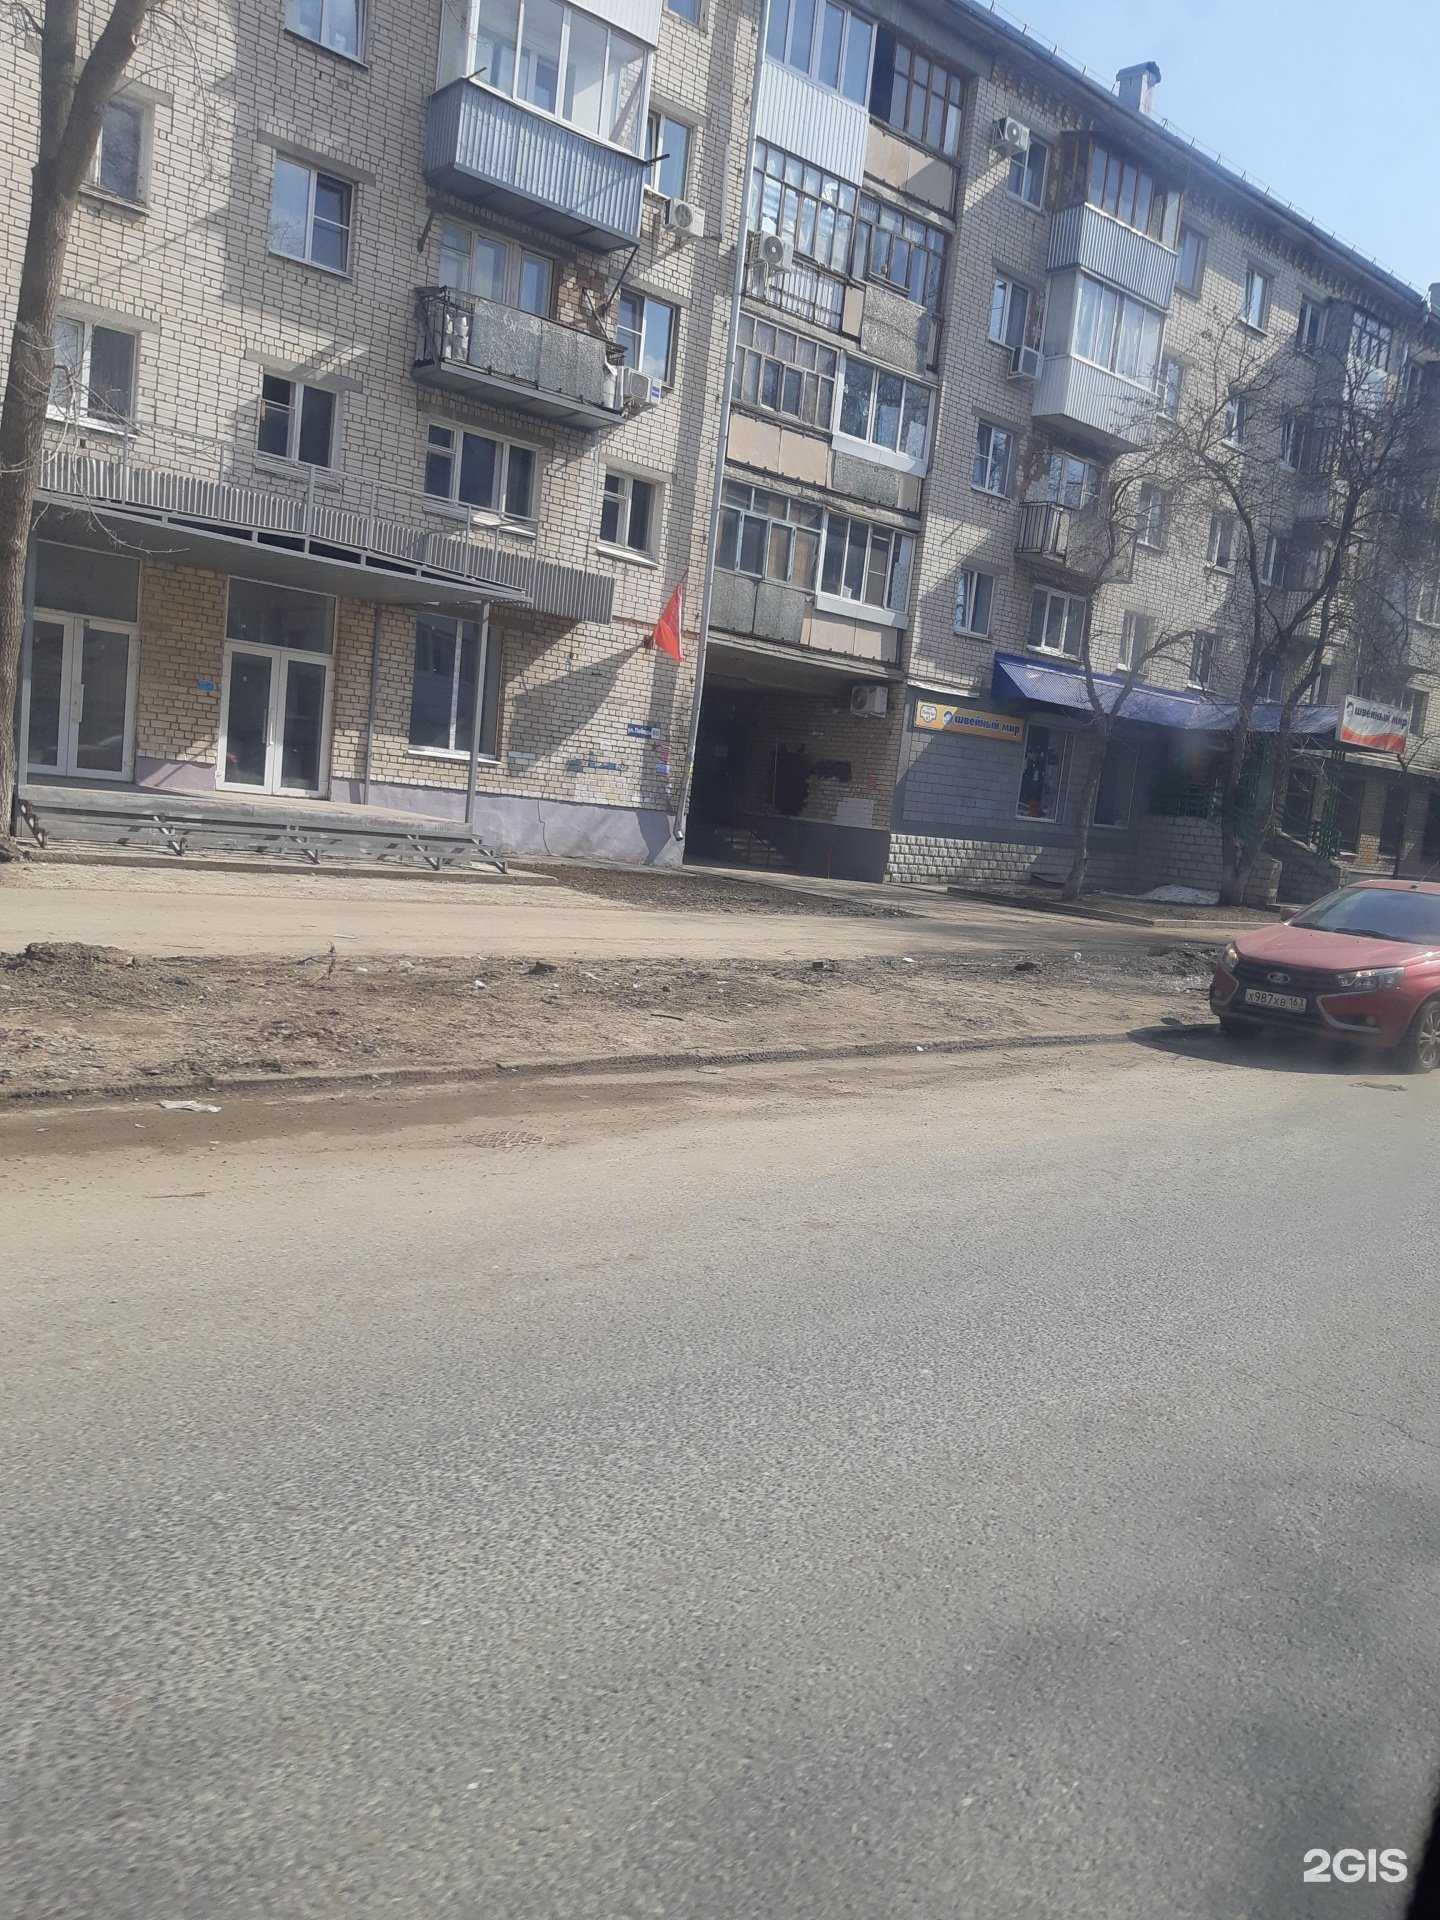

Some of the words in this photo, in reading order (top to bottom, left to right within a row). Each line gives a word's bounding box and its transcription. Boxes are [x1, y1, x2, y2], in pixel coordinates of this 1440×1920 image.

[955, 715, 999, 730] швейный
[1001, 723, 1020, 736] мир
[1354, 706, 1391, 722] швейный
[1392, 716, 1408, 730] мир
